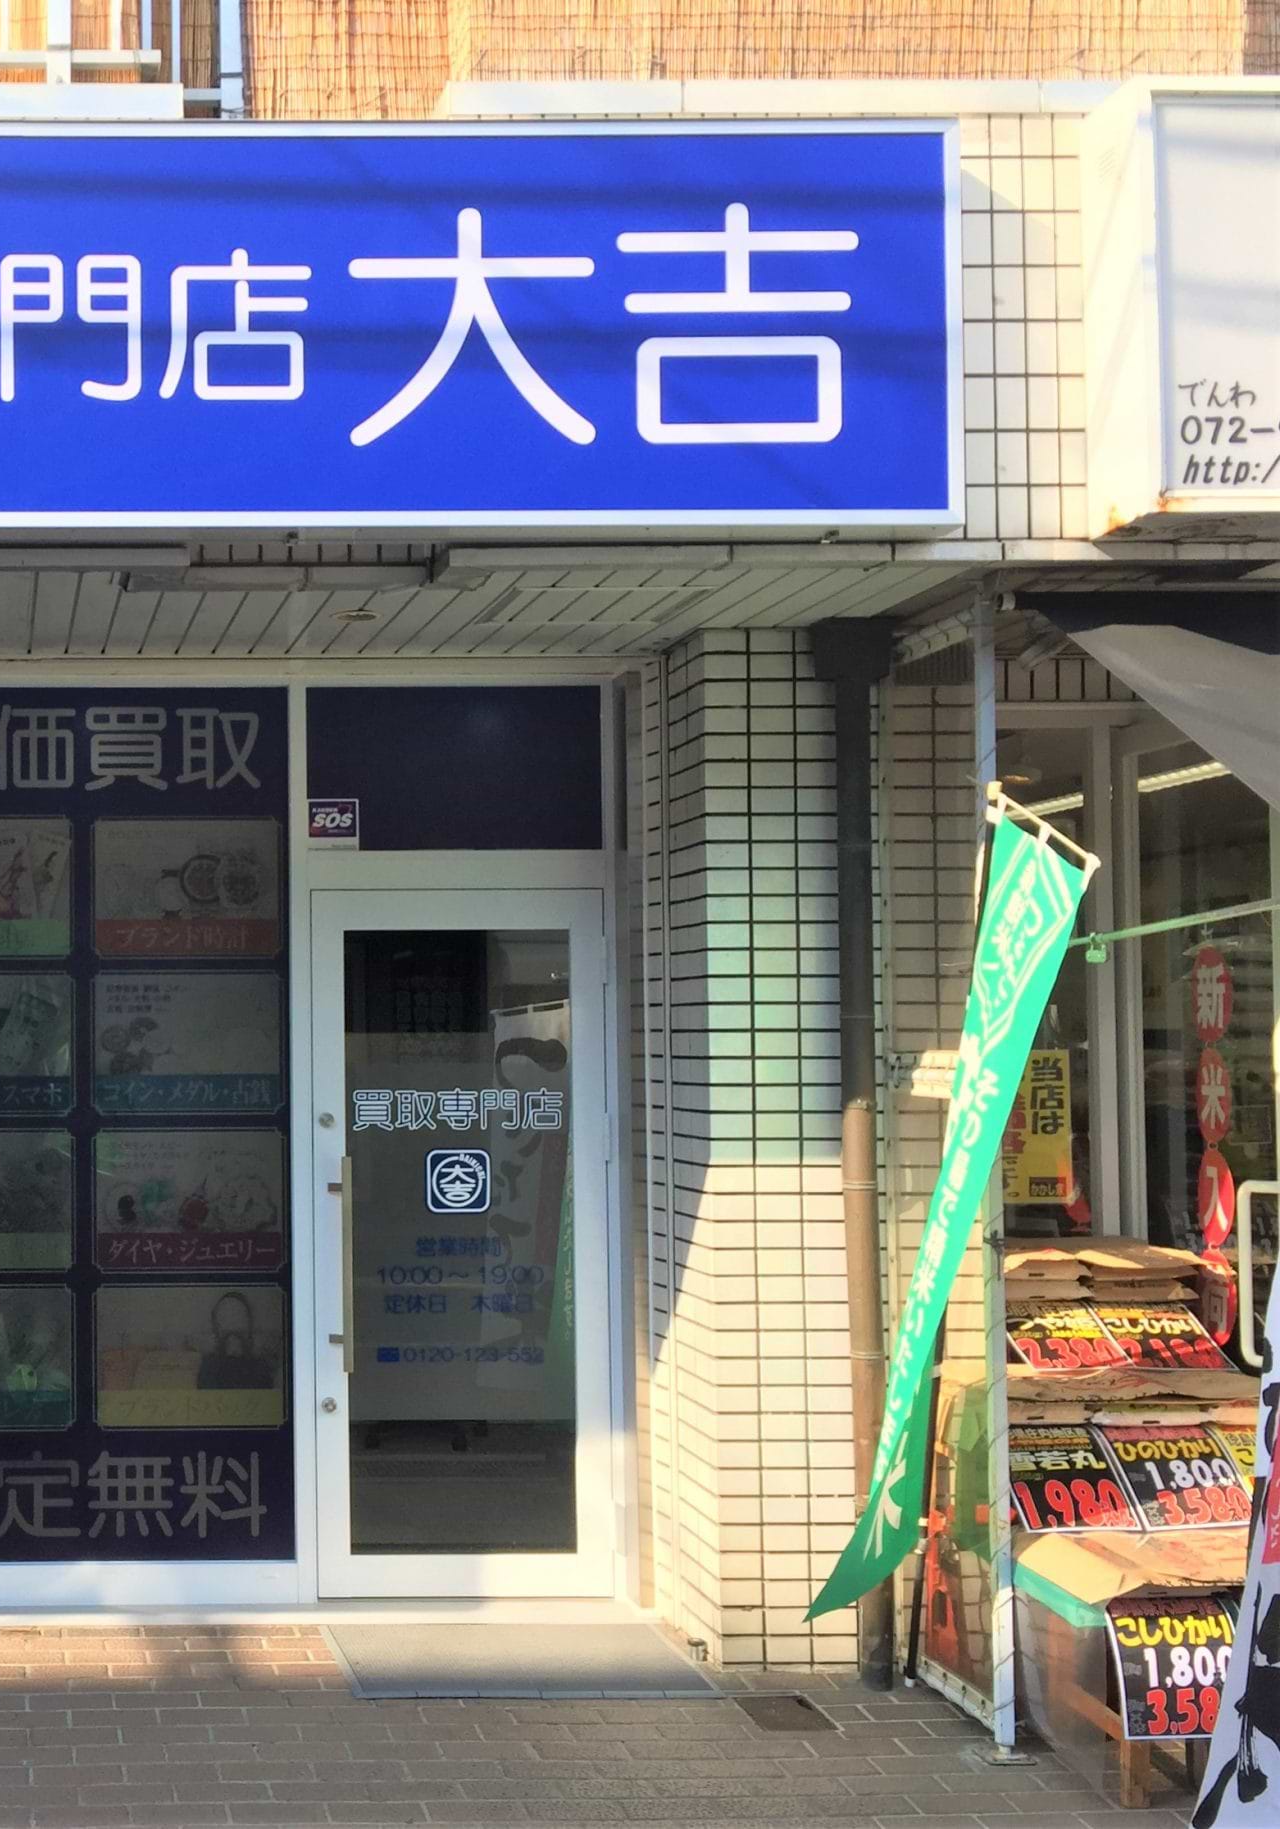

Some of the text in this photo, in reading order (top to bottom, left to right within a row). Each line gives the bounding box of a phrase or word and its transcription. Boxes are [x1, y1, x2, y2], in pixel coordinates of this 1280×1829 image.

[348, 202, 860, 447] 大吉
[1178, 379, 1256, 408] でんわ
[1180, 415, 1280, 445] 072-
[312, 812, 354, 828] SOS
[352, 1087, 564, 1131] 買取専門店
[1030, 1056, 1066, 1136] 当店は
[108, 1239, 276, 1265] ダイヤ・ジュエリー
[384, 1293, 447, 1315] 定休日
[1113, 1437, 1222, 1462] ひのひかり
[1144, 1457, 1236, 1490] 1,800
[1014, 1479, 1132, 1528] 1,980
[1156, 1485, 1252, 1526] 3,580
[1115, 1614, 1233, 1647] こしひかり
